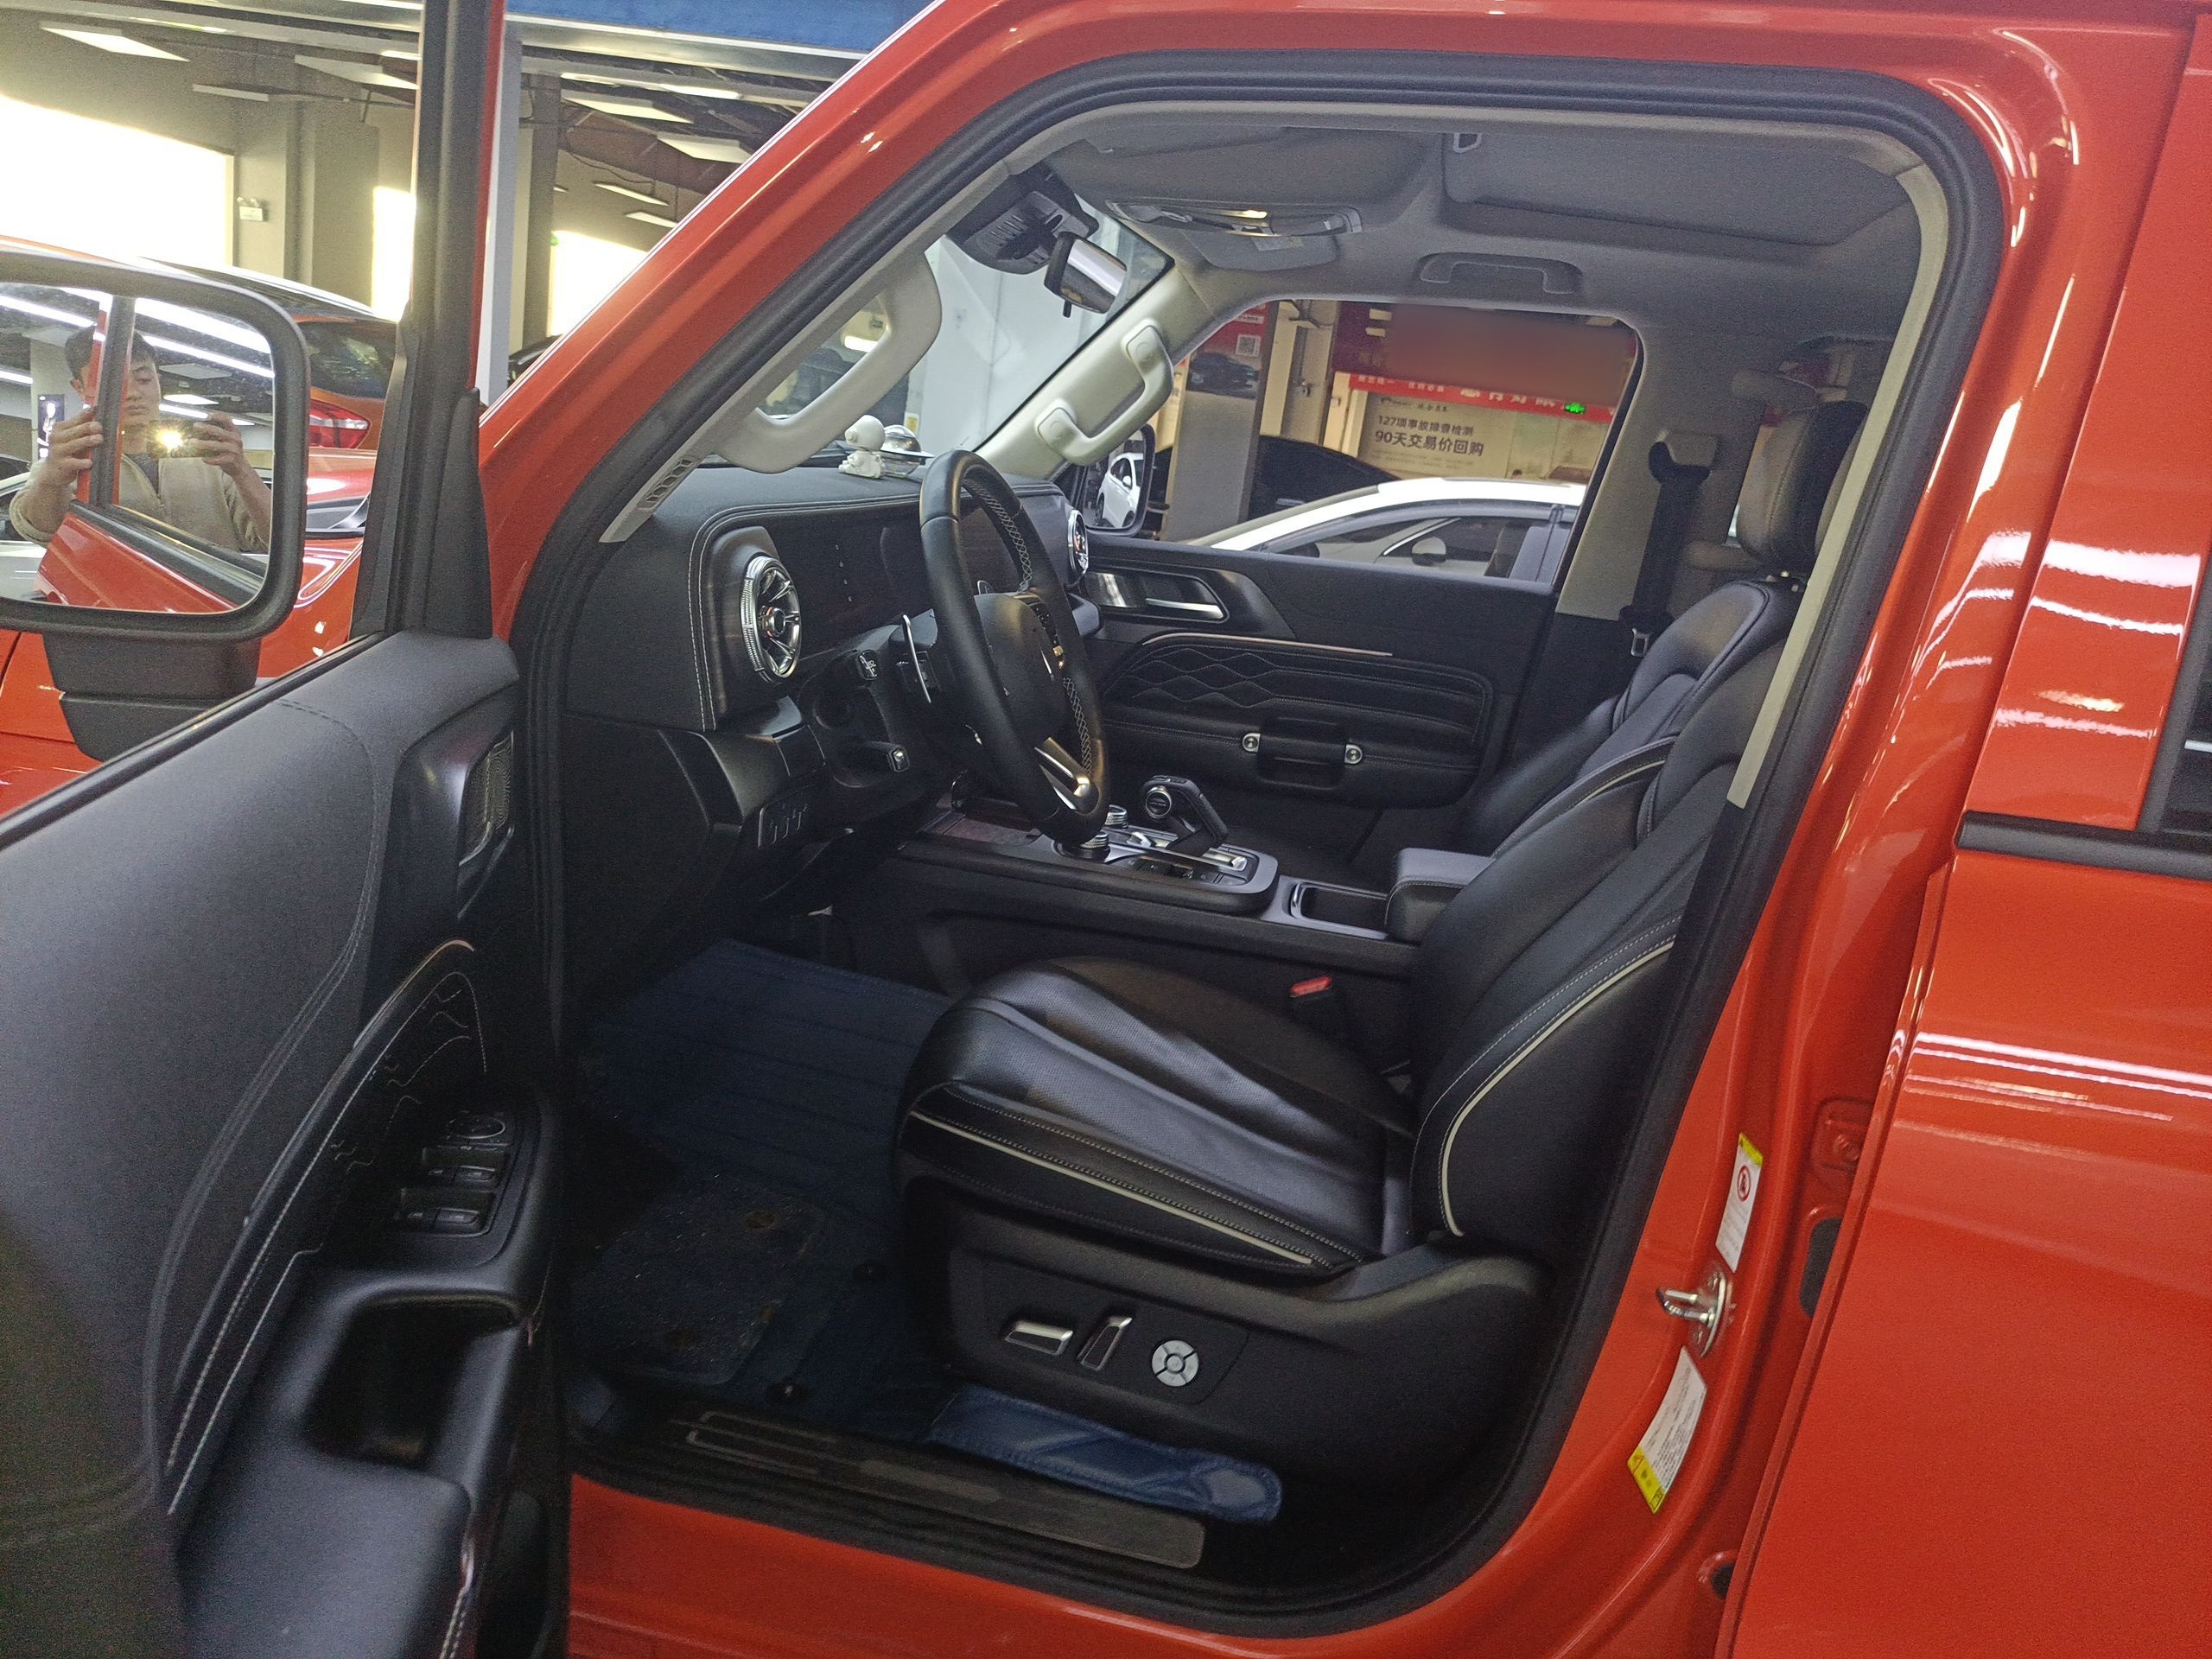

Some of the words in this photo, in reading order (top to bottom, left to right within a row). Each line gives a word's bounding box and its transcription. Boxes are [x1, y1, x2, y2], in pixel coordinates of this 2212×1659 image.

[1375, 430, 1484, 457] 90天交易价回购
